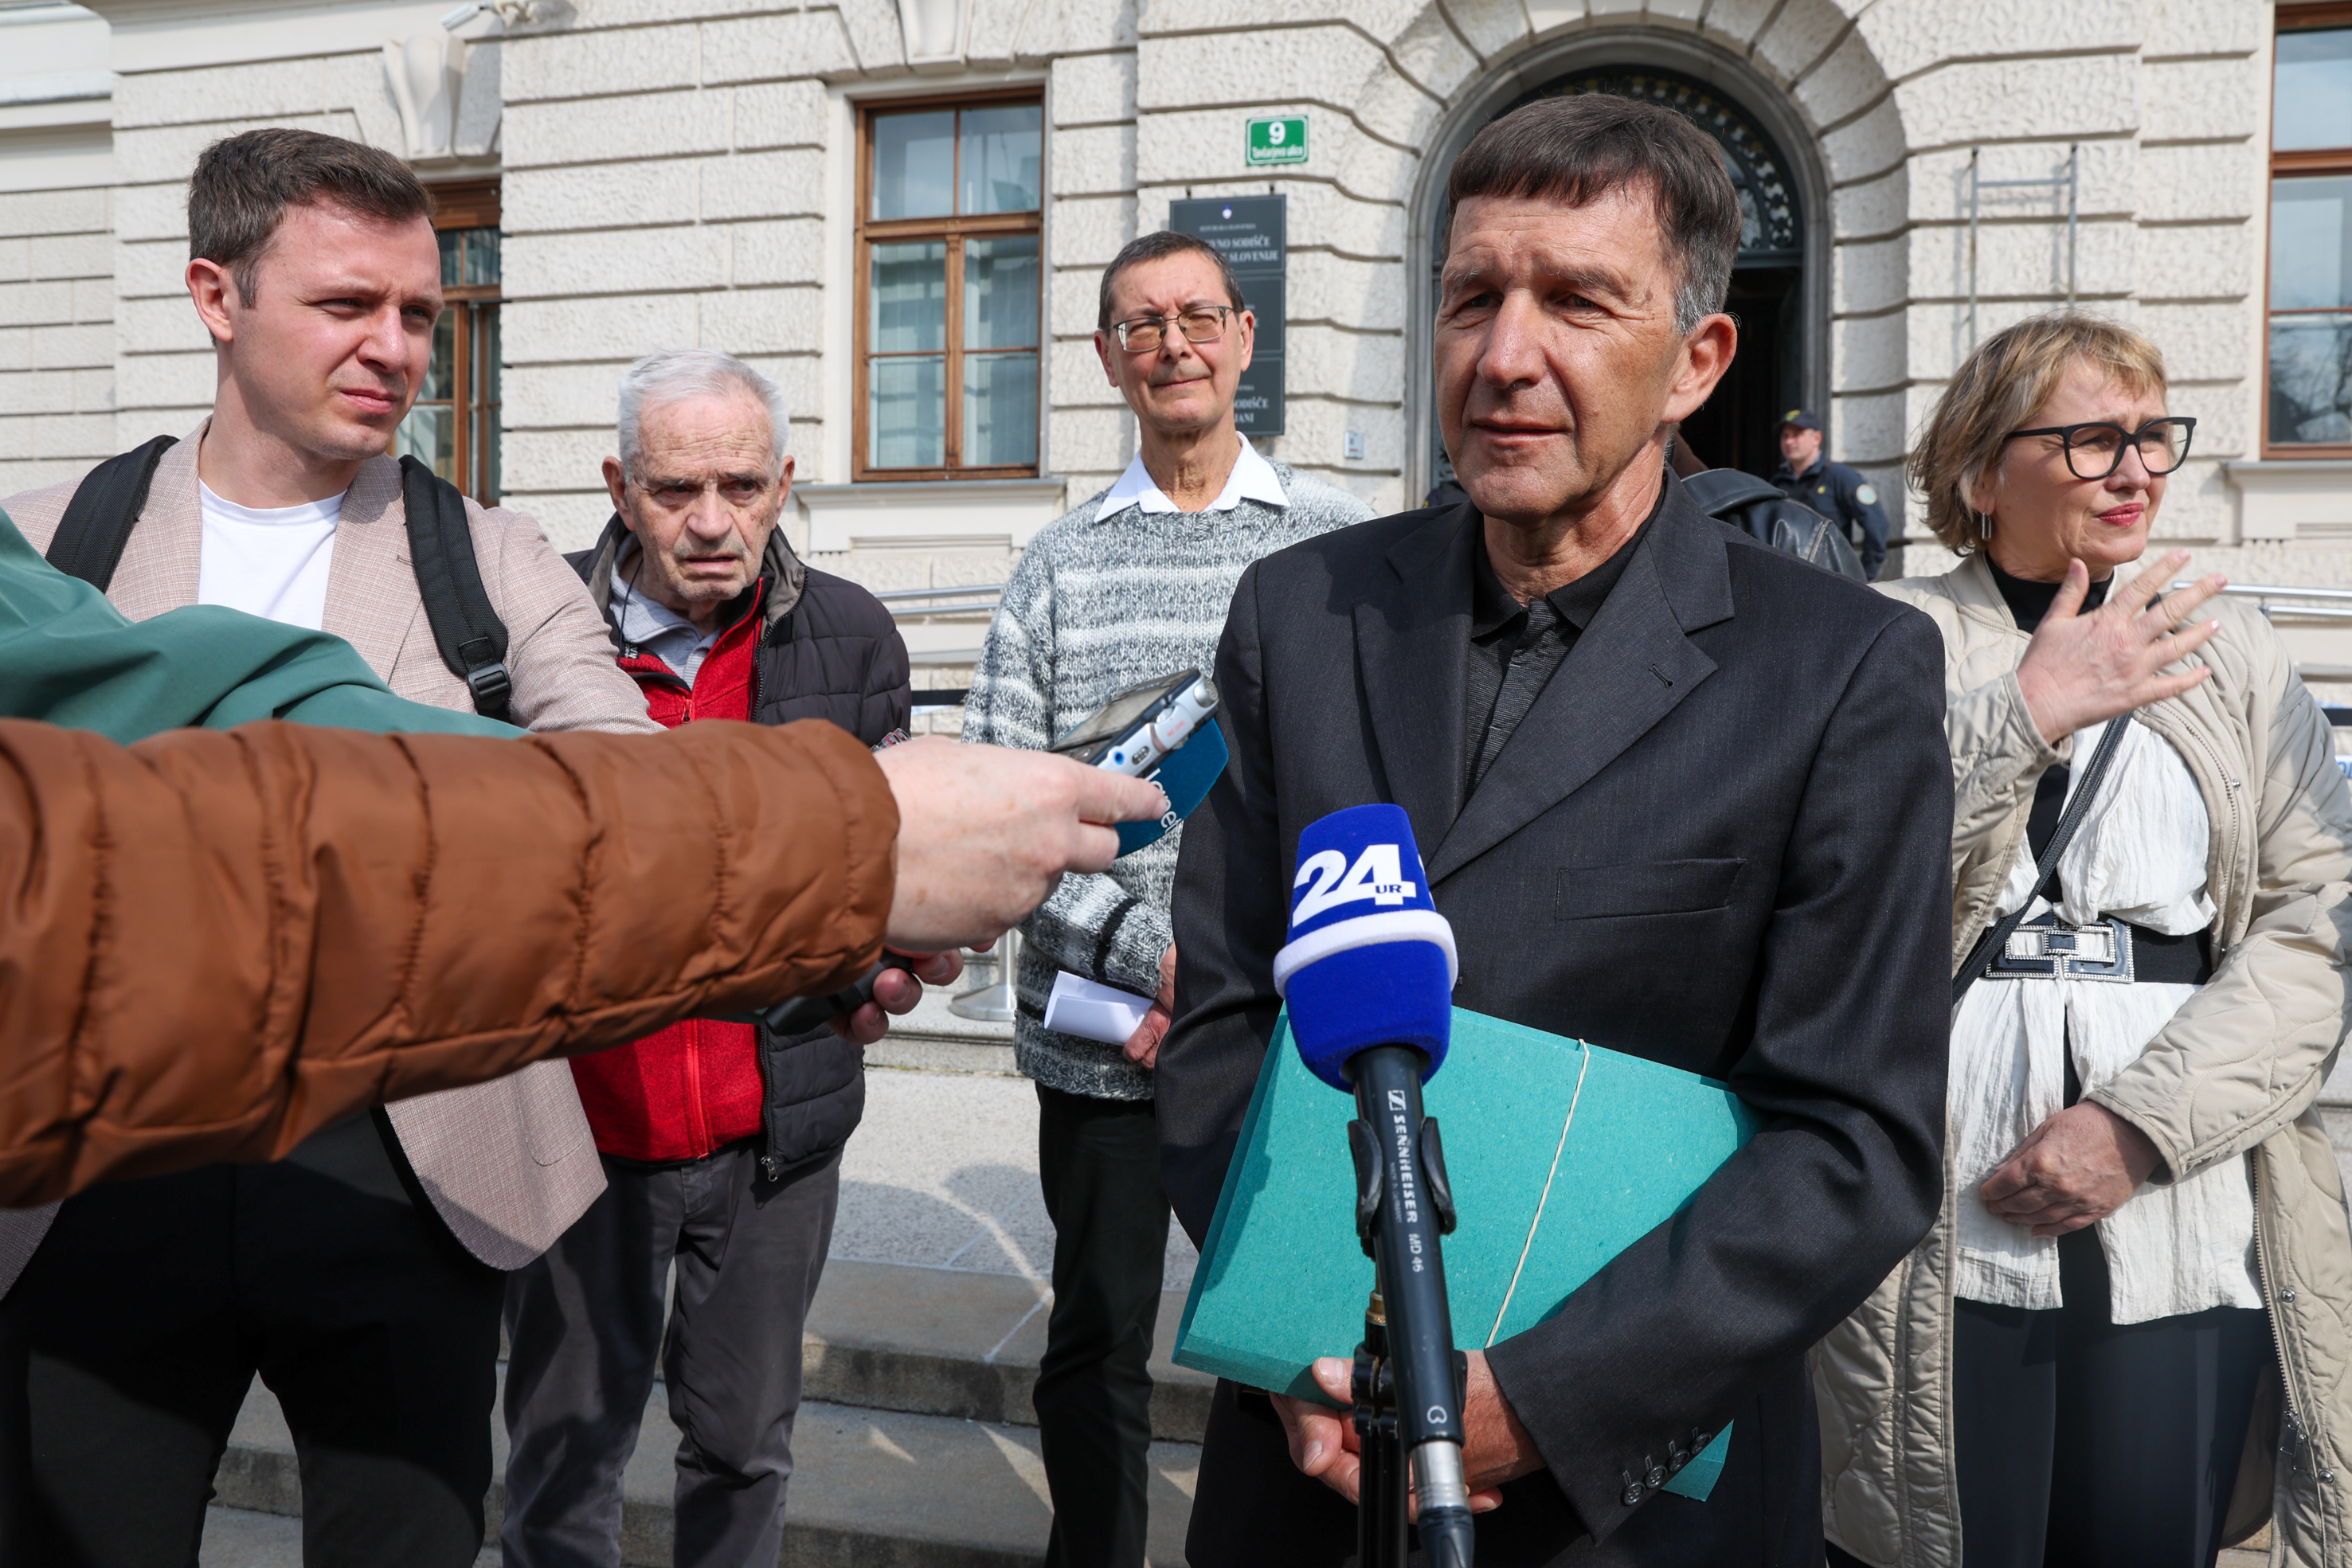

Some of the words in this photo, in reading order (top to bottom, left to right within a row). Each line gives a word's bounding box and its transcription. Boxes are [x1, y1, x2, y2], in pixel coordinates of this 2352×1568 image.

[1268, 121, 1286, 145] 9
[1234, 396, 1270, 409] ODIŠČE
[1292, 844, 1417, 929] 24
[1376, 884, 1402, 894] UR
[1394, 1115, 1418, 1223] SENNHEISER
[1408, 1233, 1423, 1254] MD
[1411, 1257, 1424, 1273] 46
